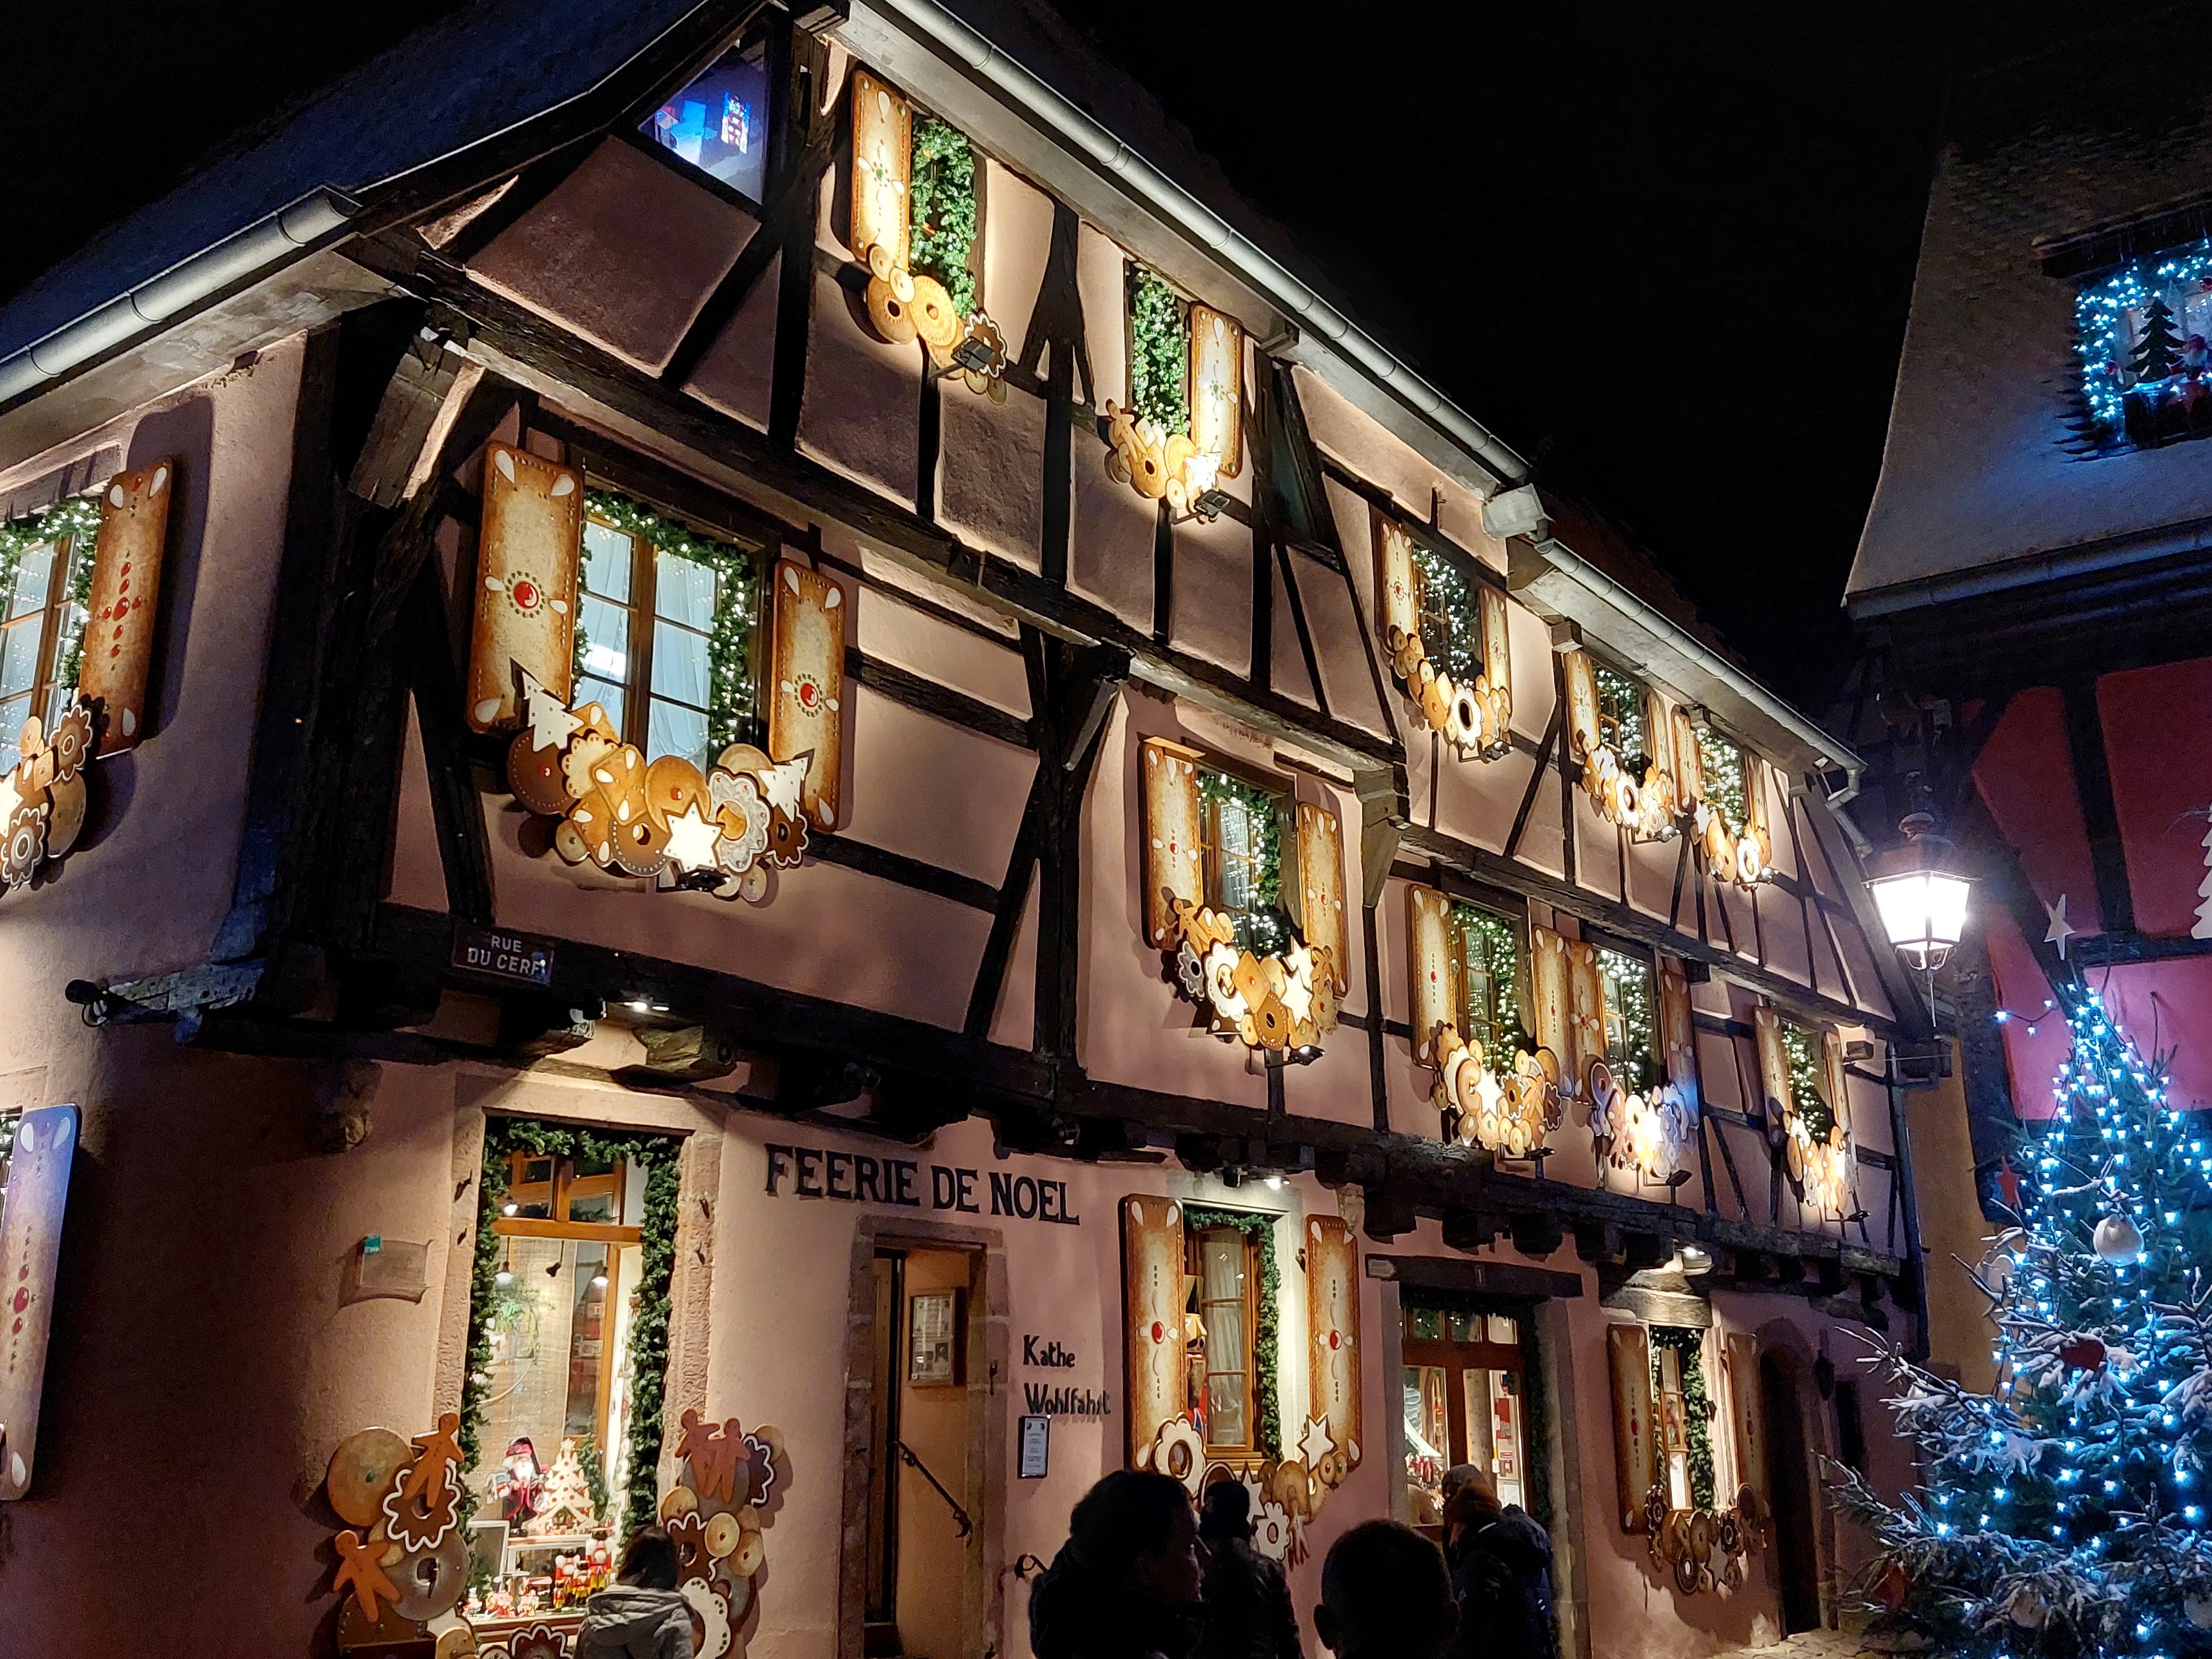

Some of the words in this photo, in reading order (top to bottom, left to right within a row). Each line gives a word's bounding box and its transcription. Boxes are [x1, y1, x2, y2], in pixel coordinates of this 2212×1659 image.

[491, 935, 522, 952] RUE
[467, 947, 491, 965] DU
[497, 954, 541, 975] CERF
[764, 1142, 920, 1206] FEERIE
[930, 1165, 980, 1213] DE
[989, 1172, 1080, 1226] NOEL
